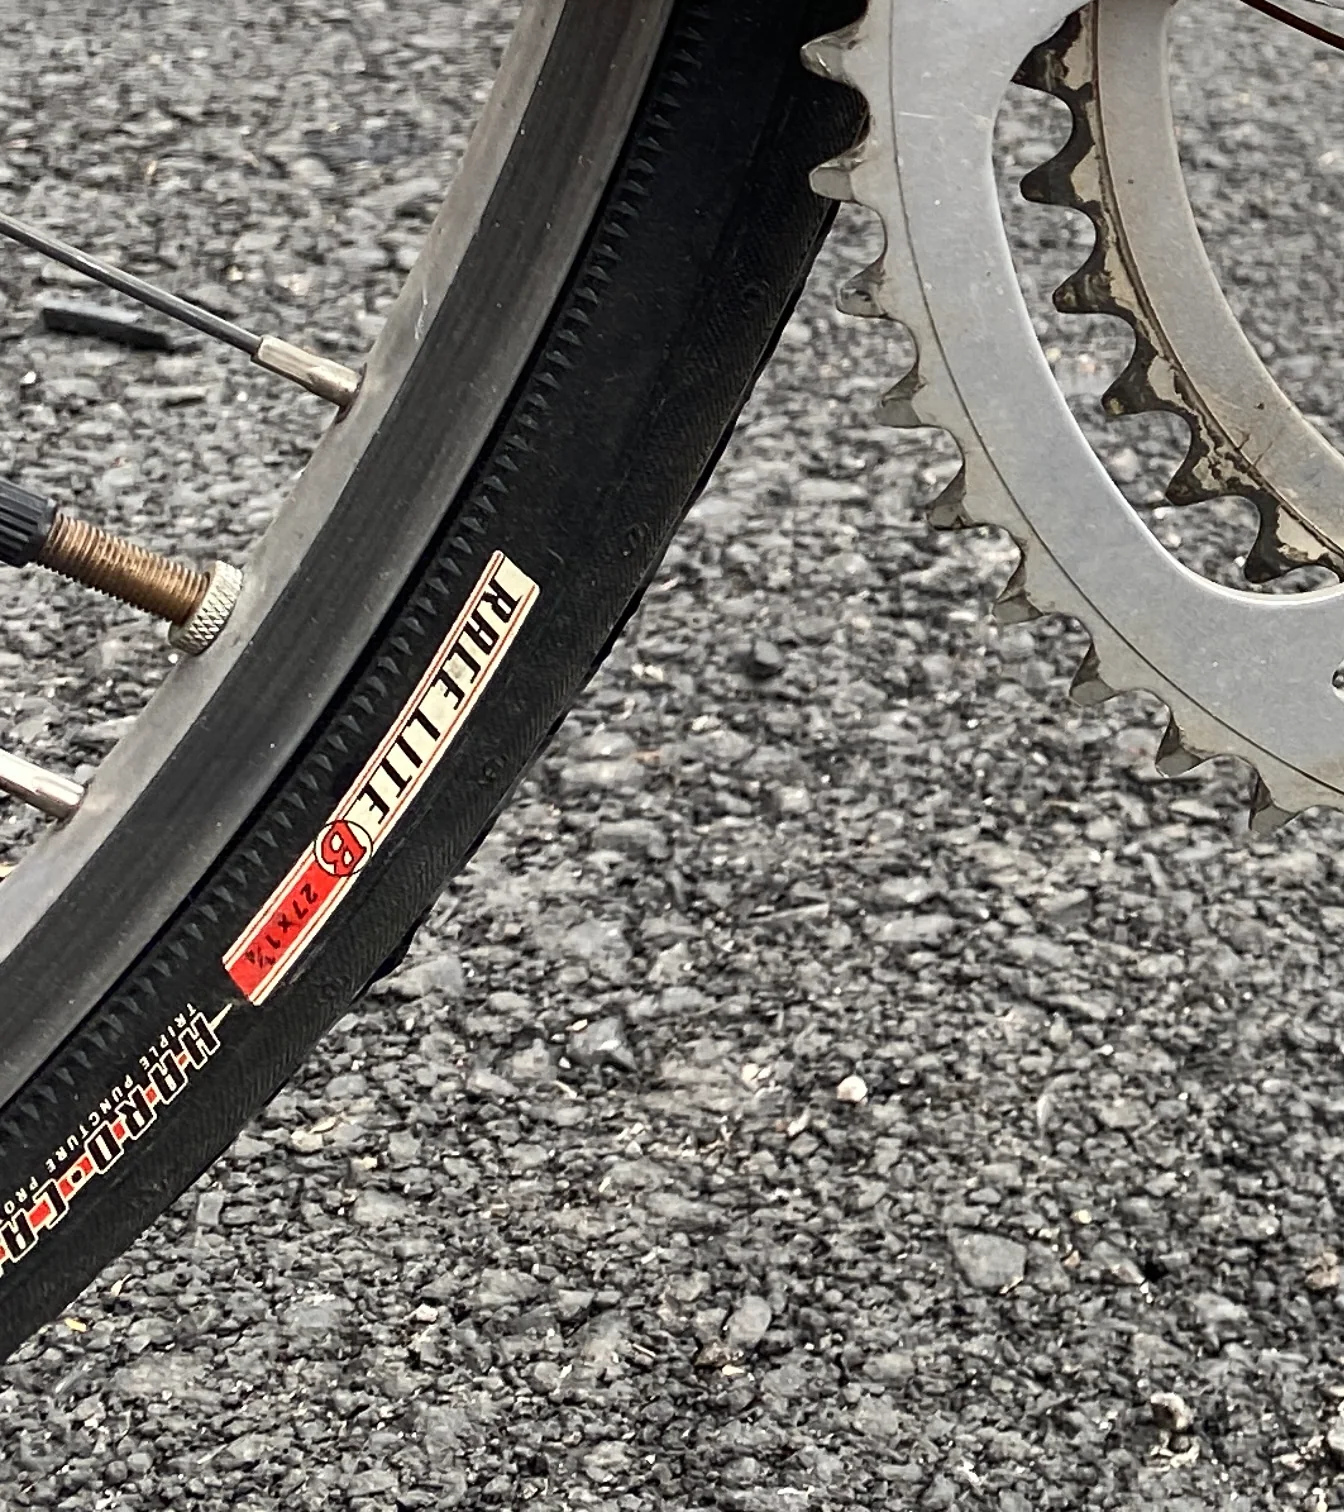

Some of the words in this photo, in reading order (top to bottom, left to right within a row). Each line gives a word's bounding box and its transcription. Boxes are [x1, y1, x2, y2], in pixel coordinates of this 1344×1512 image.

[430, 580, 524, 711] RACE
[357, 713, 442, 825] LITE
[139, 1002, 197, 1070] TRIPLE
[45, 1074, 134, 1174] PUNCTURE
[0, 1176, 39, 1224] PRO
